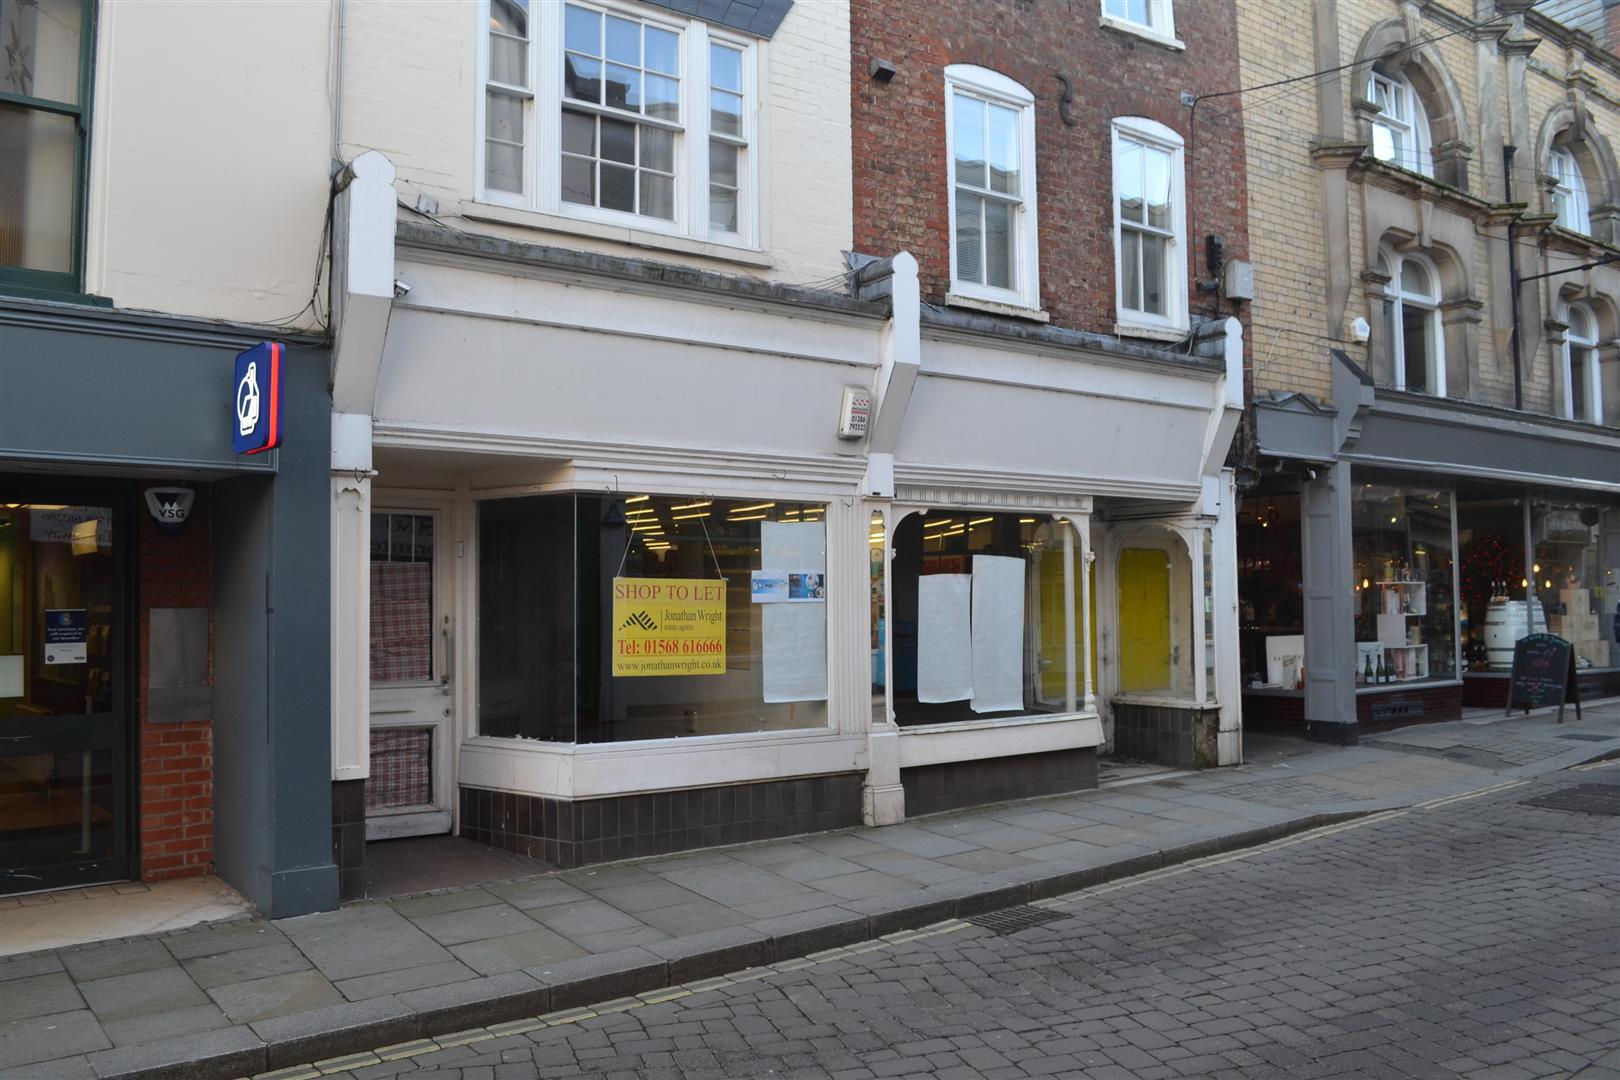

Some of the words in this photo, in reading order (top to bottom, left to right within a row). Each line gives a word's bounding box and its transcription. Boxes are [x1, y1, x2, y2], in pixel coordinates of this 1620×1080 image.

[159, 508, 185, 519] VSG
[615, 584, 661, 600] SHOP
[666, 585, 689, 600] TO
[694, 586, 725, 601] LET
[664, 609, 697, 622] Jonathan
[698, 609, 722, 624] Wright
[679, 624, 694, 632] agents
[617, 640, 640, 655] Tel:
[644, 640, 679, 654] 01568
[682, 639, 722, 653] 616666
[617, 659, 722, 672] www.jonathanwright.co.uk
